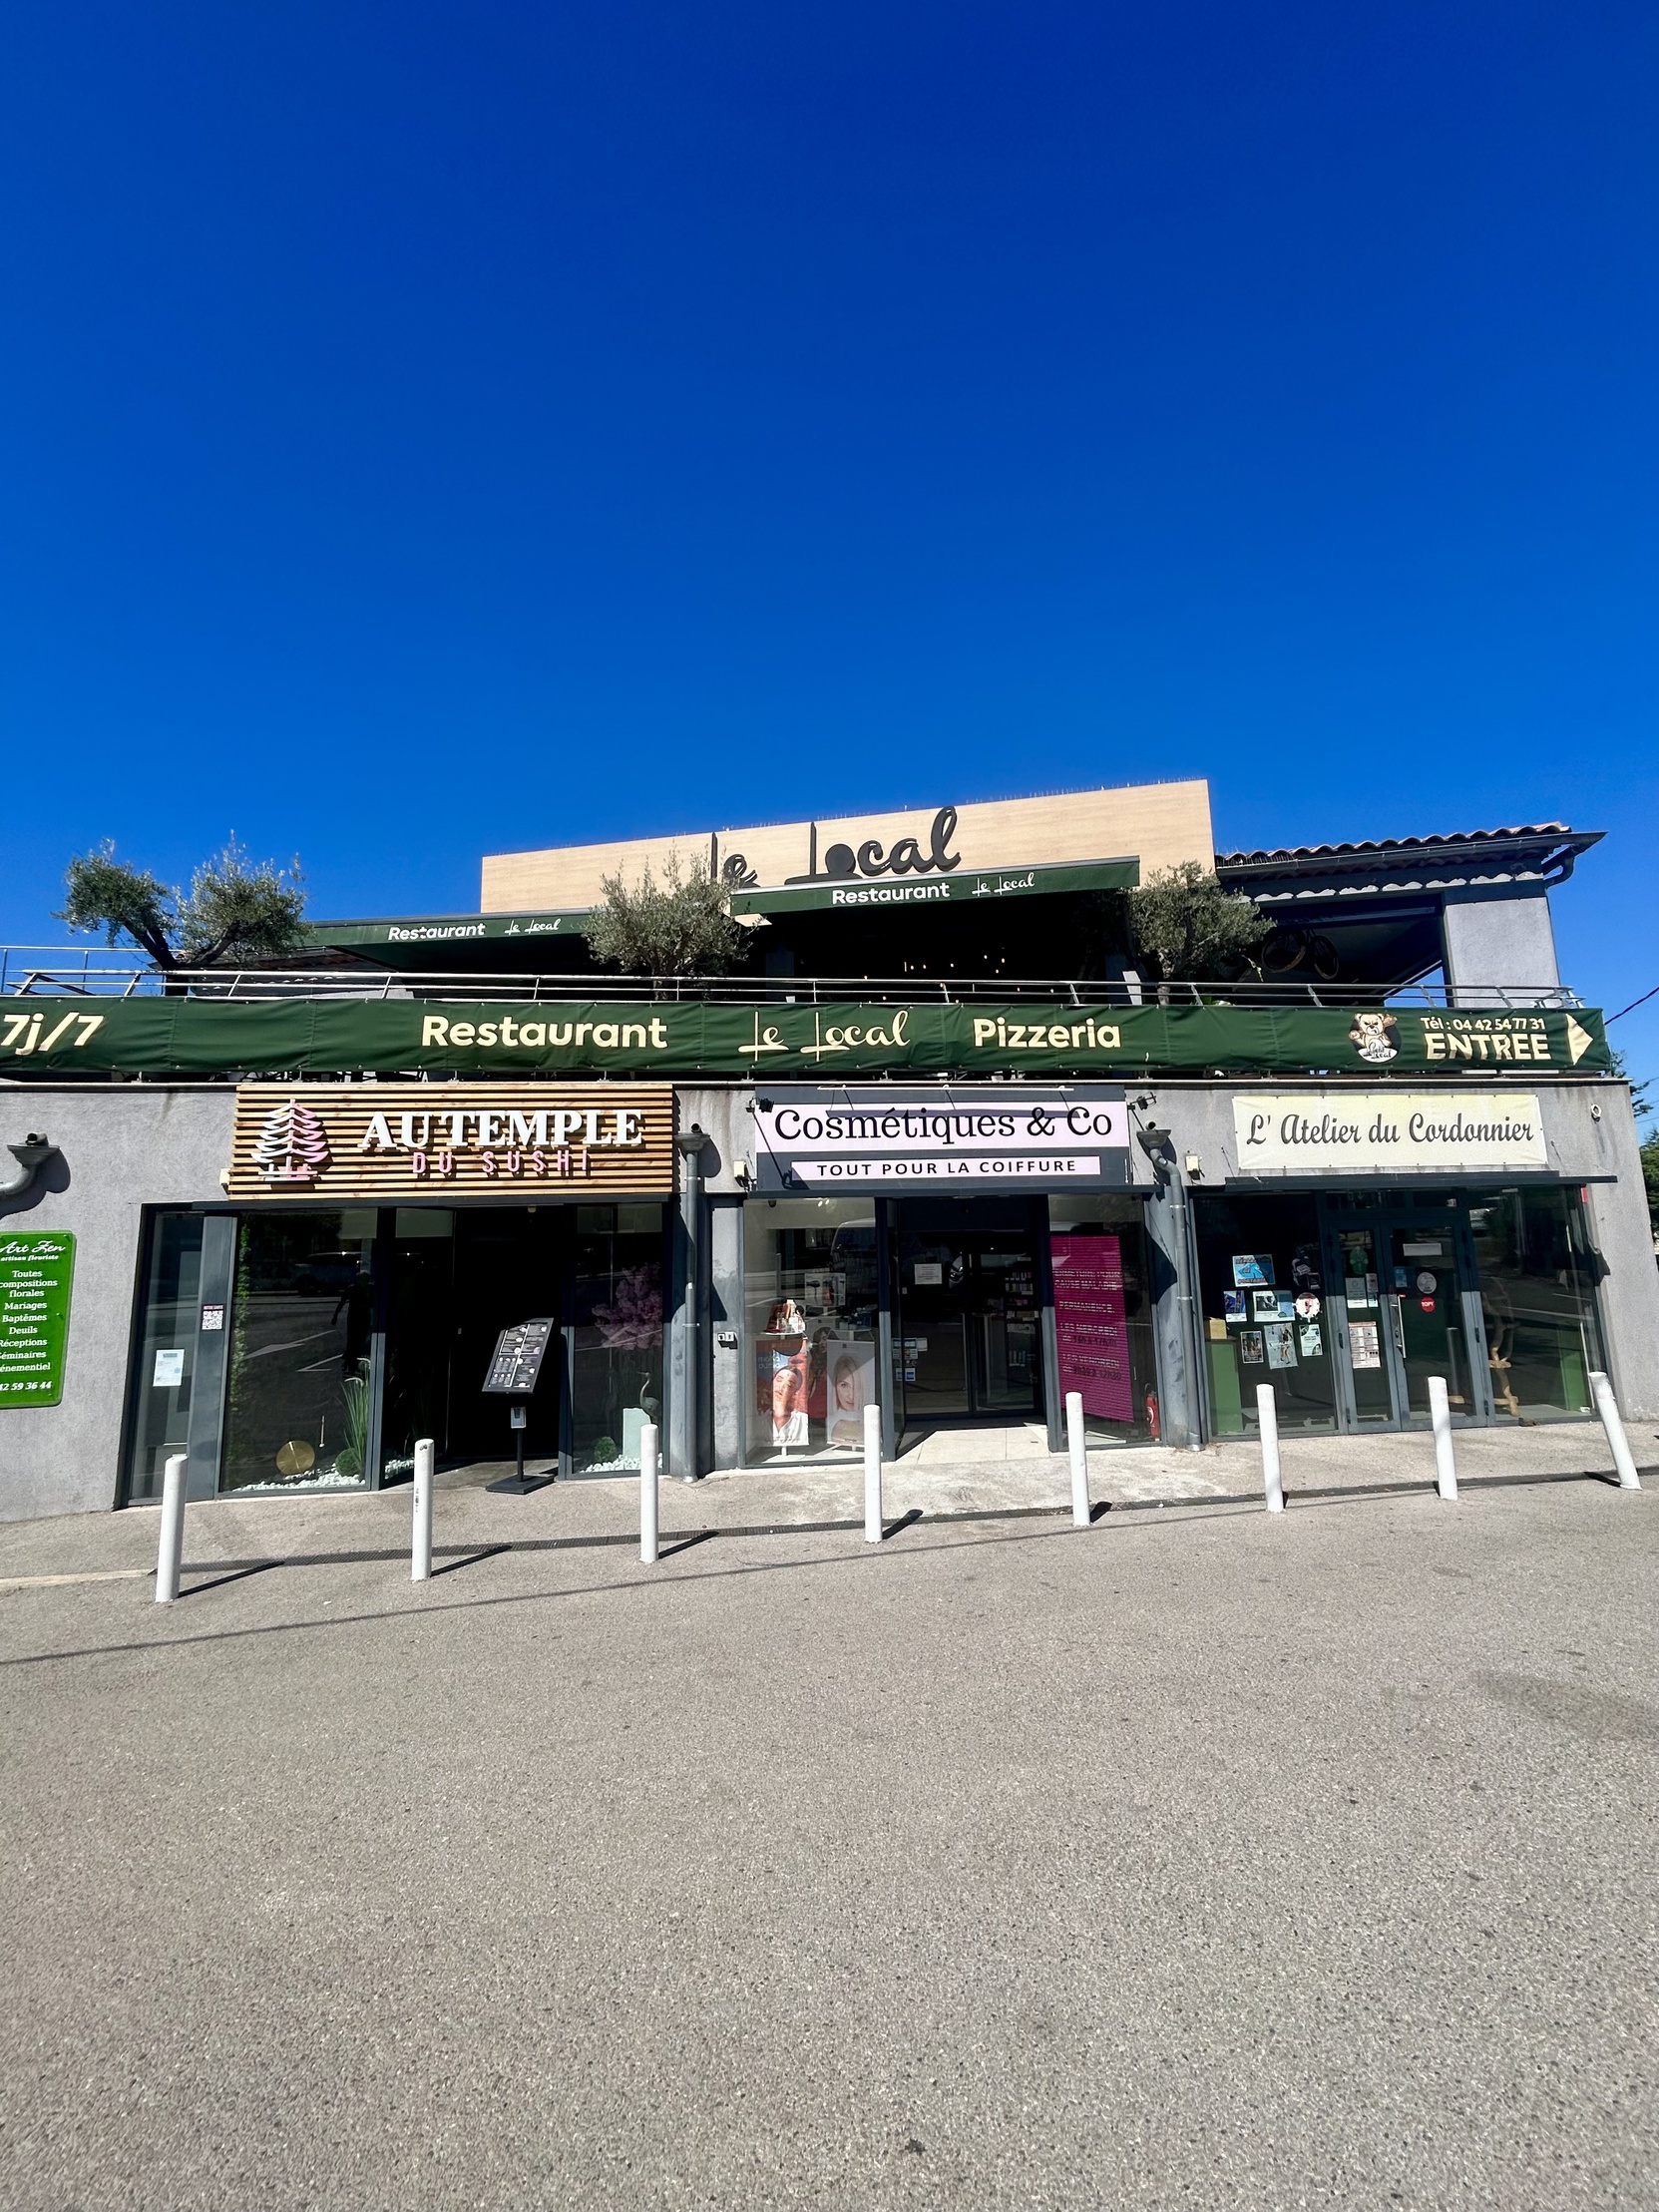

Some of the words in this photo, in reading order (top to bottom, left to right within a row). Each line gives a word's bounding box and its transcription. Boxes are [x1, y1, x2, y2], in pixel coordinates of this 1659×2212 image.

[785, 805, 962, 886] Local
[832, 882, 951, 905] Restaurant
[971, 877, 991, 897] Le
[994, 872, 1035, 896] Local
[388, 922, 486, 941] Restaurant
[504, 919, 521, 936] Le
[524, 918, 562, 935] Local
[1420, 1017, 1444, 1031] Tél
[1452, 1018, 1472, 1032] 04
[1476, 1018, 1492, 1032] 42
[1494, 1018, 1512, 1032] 54
[1511, 1017, 1528, 1031] 77
[1530, 1018, 1546, 1031] 31
[0, 1012, 105, 1056] 7j/7
[421, 1015, 668, 1049] Restaurant
[737, 1011, 790, 1062] Le
[799, 1010, 912, 1063] Local
[973, 1017, 1121, 1049] Pizzeria
[1424, 1033, 1552, 1061] ENTREE
[774, 1106, 1017, 1145] Cosmétiques
[1027, 1106, 1056, 1136] &
[1065, 1106, 1113, 1136] Co
[1246, 1113, 1272, 1145] L'
[1280, 1112, 1363, 1145] Atelier
[1368, 1112, 1402, 1144] du
[1408, 1111, 1535, 1144] Cordonnier
[412, 1150, 453, 1174] DU
[482, 1149, 590, 1173] SUSHI
[817, 1163, 873, 1177] TOUT
[882, 1162, 939, 1176] POUR
[947, 1161, 971, 1174] LA
[979, 1159, 1077, 1174] COIFFURE
[0, 1240, 29, 1254] Art
[32, 1239, 67, 1254] Zen
[27, 1253, 60, 1262] fleuriste
[12, 1269, 43, 1278] Toutes
[0, 1279, 59, 1289] compositions
[9, 1289, 46, 1298] florales
[4, 1301, 48, 1311] Mariages
[2, 1313, 48, 1324] Baptêmes
[9, 1325, 39, 1335] Deuils
[0, 1361, 51, 1373] énementiel
[11, 1382, 24, 1391] 59
[25, 1381, 39, 1390] 36
[40, 1380, 53, 1390] 44
